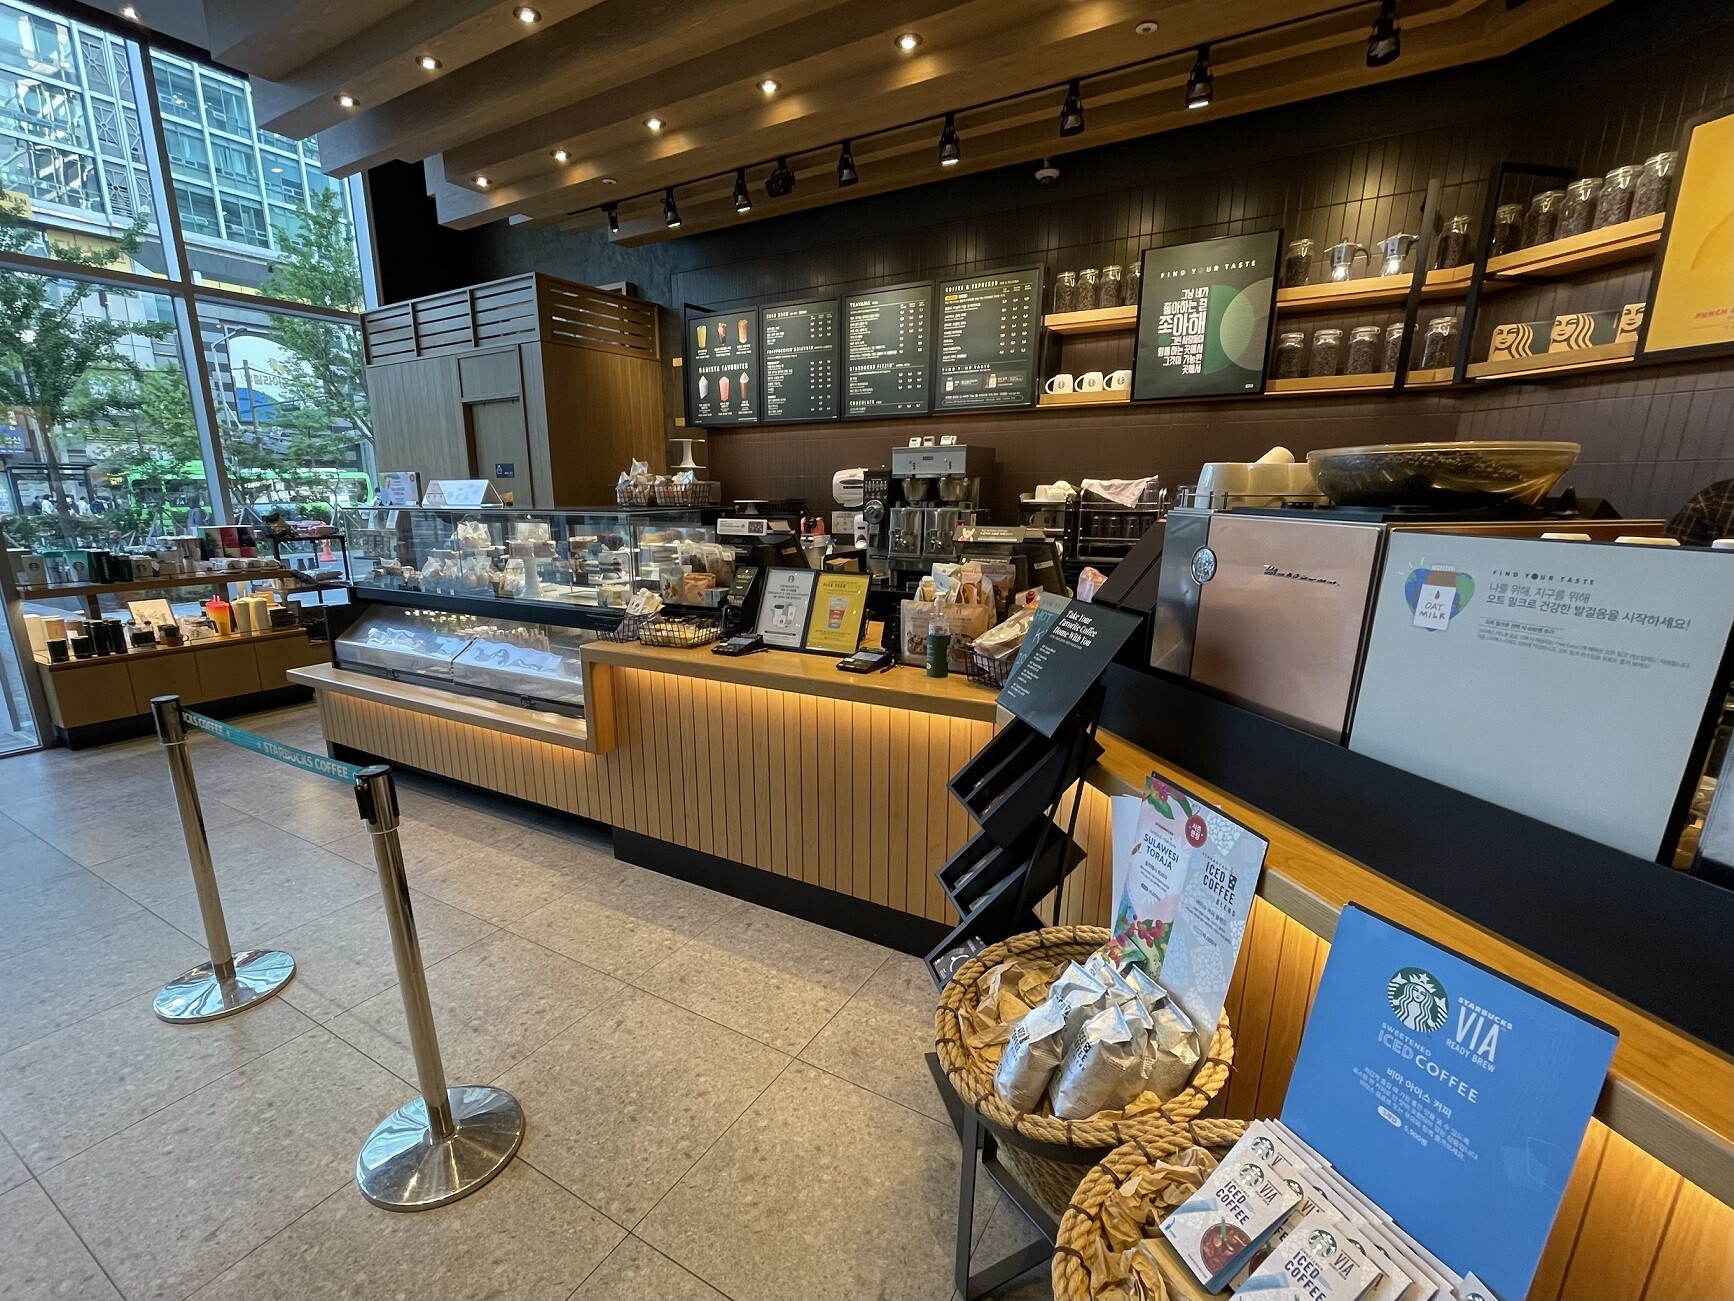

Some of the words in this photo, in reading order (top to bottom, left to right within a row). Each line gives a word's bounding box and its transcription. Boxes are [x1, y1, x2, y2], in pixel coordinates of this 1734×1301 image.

[1161, 270, 1186, 278] FIND
[1225, 260, 1256, 270] TASTE
[1180, 288, 1194, 300] 그냥
[1163, 300, 1197, 315] 좋아하는
[1158, 310, 1207, 336] 조아해
[699, 365, 720, 374] BARISTA
[721, 363, 749, 372] FAVORITES
[1490, 582, 1509, 594] 나를
[1535, 587, 1566, 601] 지구를
[1560, 576, 1595, 586] TASTE
[1035, 609, 1054, 624] HOT
[1066, 610, 1080, 620] Take
[1078, 614, 1093, 625] Your
[1419, 611, 1446, 619] MILK
[1425, 602, 1444, 611] OAT
[1486, 595, 1506, 605] 오트
[1508, 597, 1537, 609] 밀크로
[1540, 600, 1571, 614] 건강한
[1574, 605, 1619, 622] 발걸음을
[1622, 612, 1692, 631] 시작하세요!
[1053, 626, 1069, 638] Home
[1068, 631, 1082, 643] With
[1080, 636, 1092, 647] You
[1059, 618, 1081, 632] Favorite
[1080, 625, 1098, 638] Coffee
[198, 717, 224, 736] COFFEE
[263, 742, 314, 768] STARBUCKS
[315, 753, 348, 779] COFFEE
[1144, 833, 1179, 863] SULAWESI
[1146, 845, 1172, 870] TORAJA
[1206, 862, 1226, 883] ICED
[1203, 874, 1235, 905] COFFEE
[1216, 898, 1236, 917] BLEND
[1458, 997, 1513, 1030] STARBUCKS
[1382, 1022, 1432, 1057] SWEETENED
[1456, 1006, 1500, 1062] VIA
[1377, 1029, 1414, 1060] ICED
[1415, 1055, 1478, 1104] COFFEE
[1446, 1038, 1471, 1058] READY
[1471, 1054, 1497, 1073] BREW
[1387, 1068, 1404, 1084] 비아
[1405, 1080, 1431, 1104] 아이스
[1433, 1100, 1452, 1119] 커피
[1224, 1181, 1246, 1204] ICED
[1260, 1183, 1278, 1203] VIA
[1215, 1188, 1250, 1226] COFFEE
[1293, 1251, 1320, 1280] ICED
[1334, 1253, 1354, 1277] VIA
[1284, 1260, 1327, 1301] COFFEE
